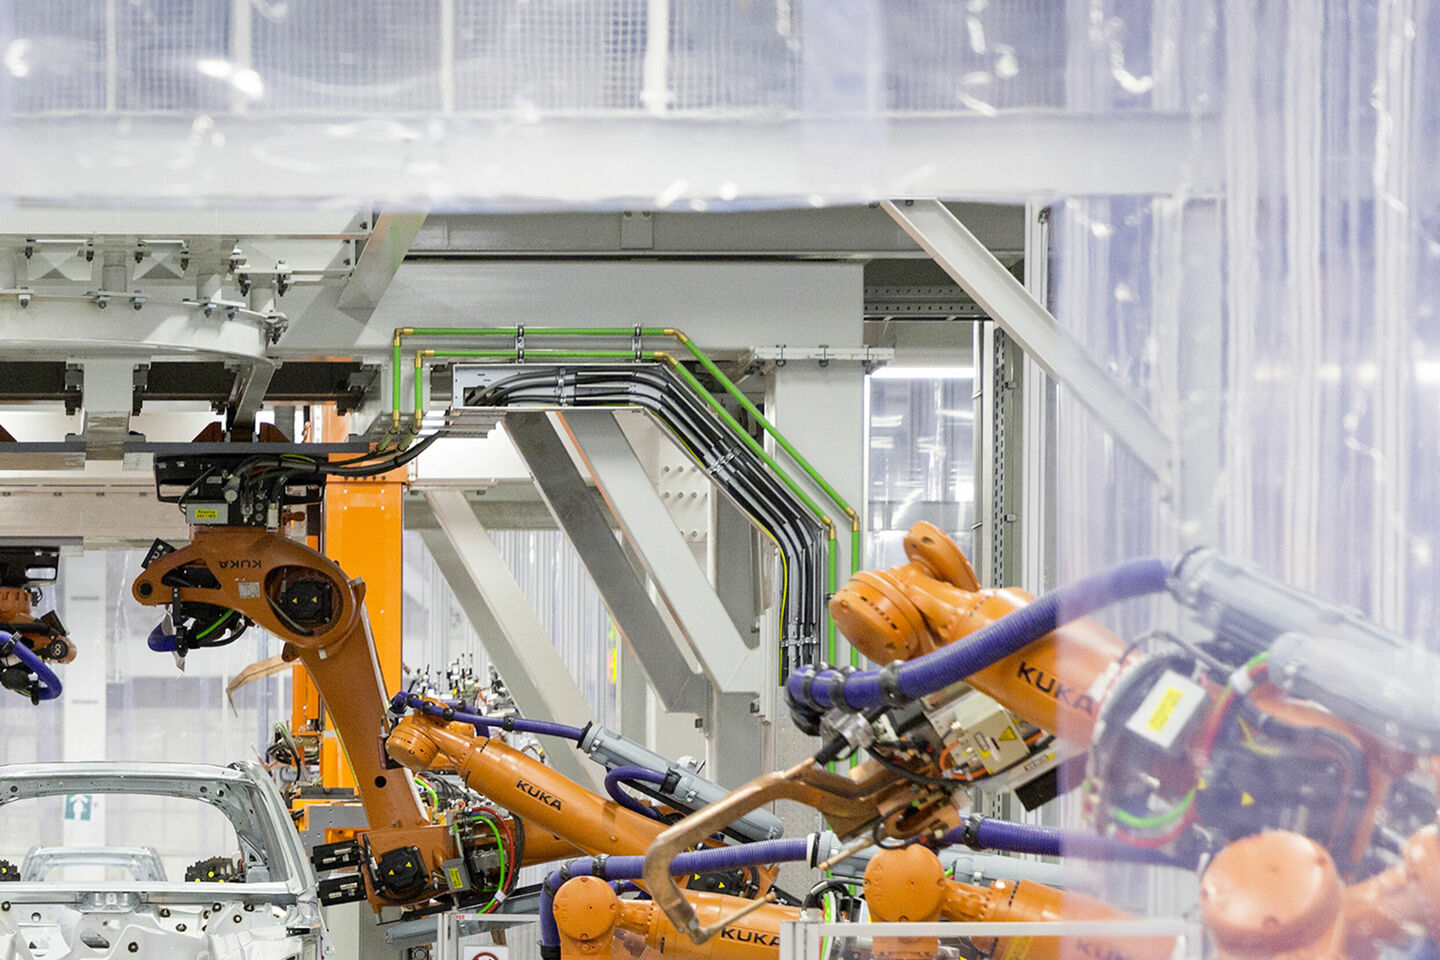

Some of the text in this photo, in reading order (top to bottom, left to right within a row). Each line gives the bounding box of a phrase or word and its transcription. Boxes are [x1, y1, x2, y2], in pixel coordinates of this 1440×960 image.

[219, 560, 262, 569] KUKA
[1017, 661, 1093, 717] KUKA
[516, 780, 562, 811] KUKA
[720, 927, 780, 946] KUKA
